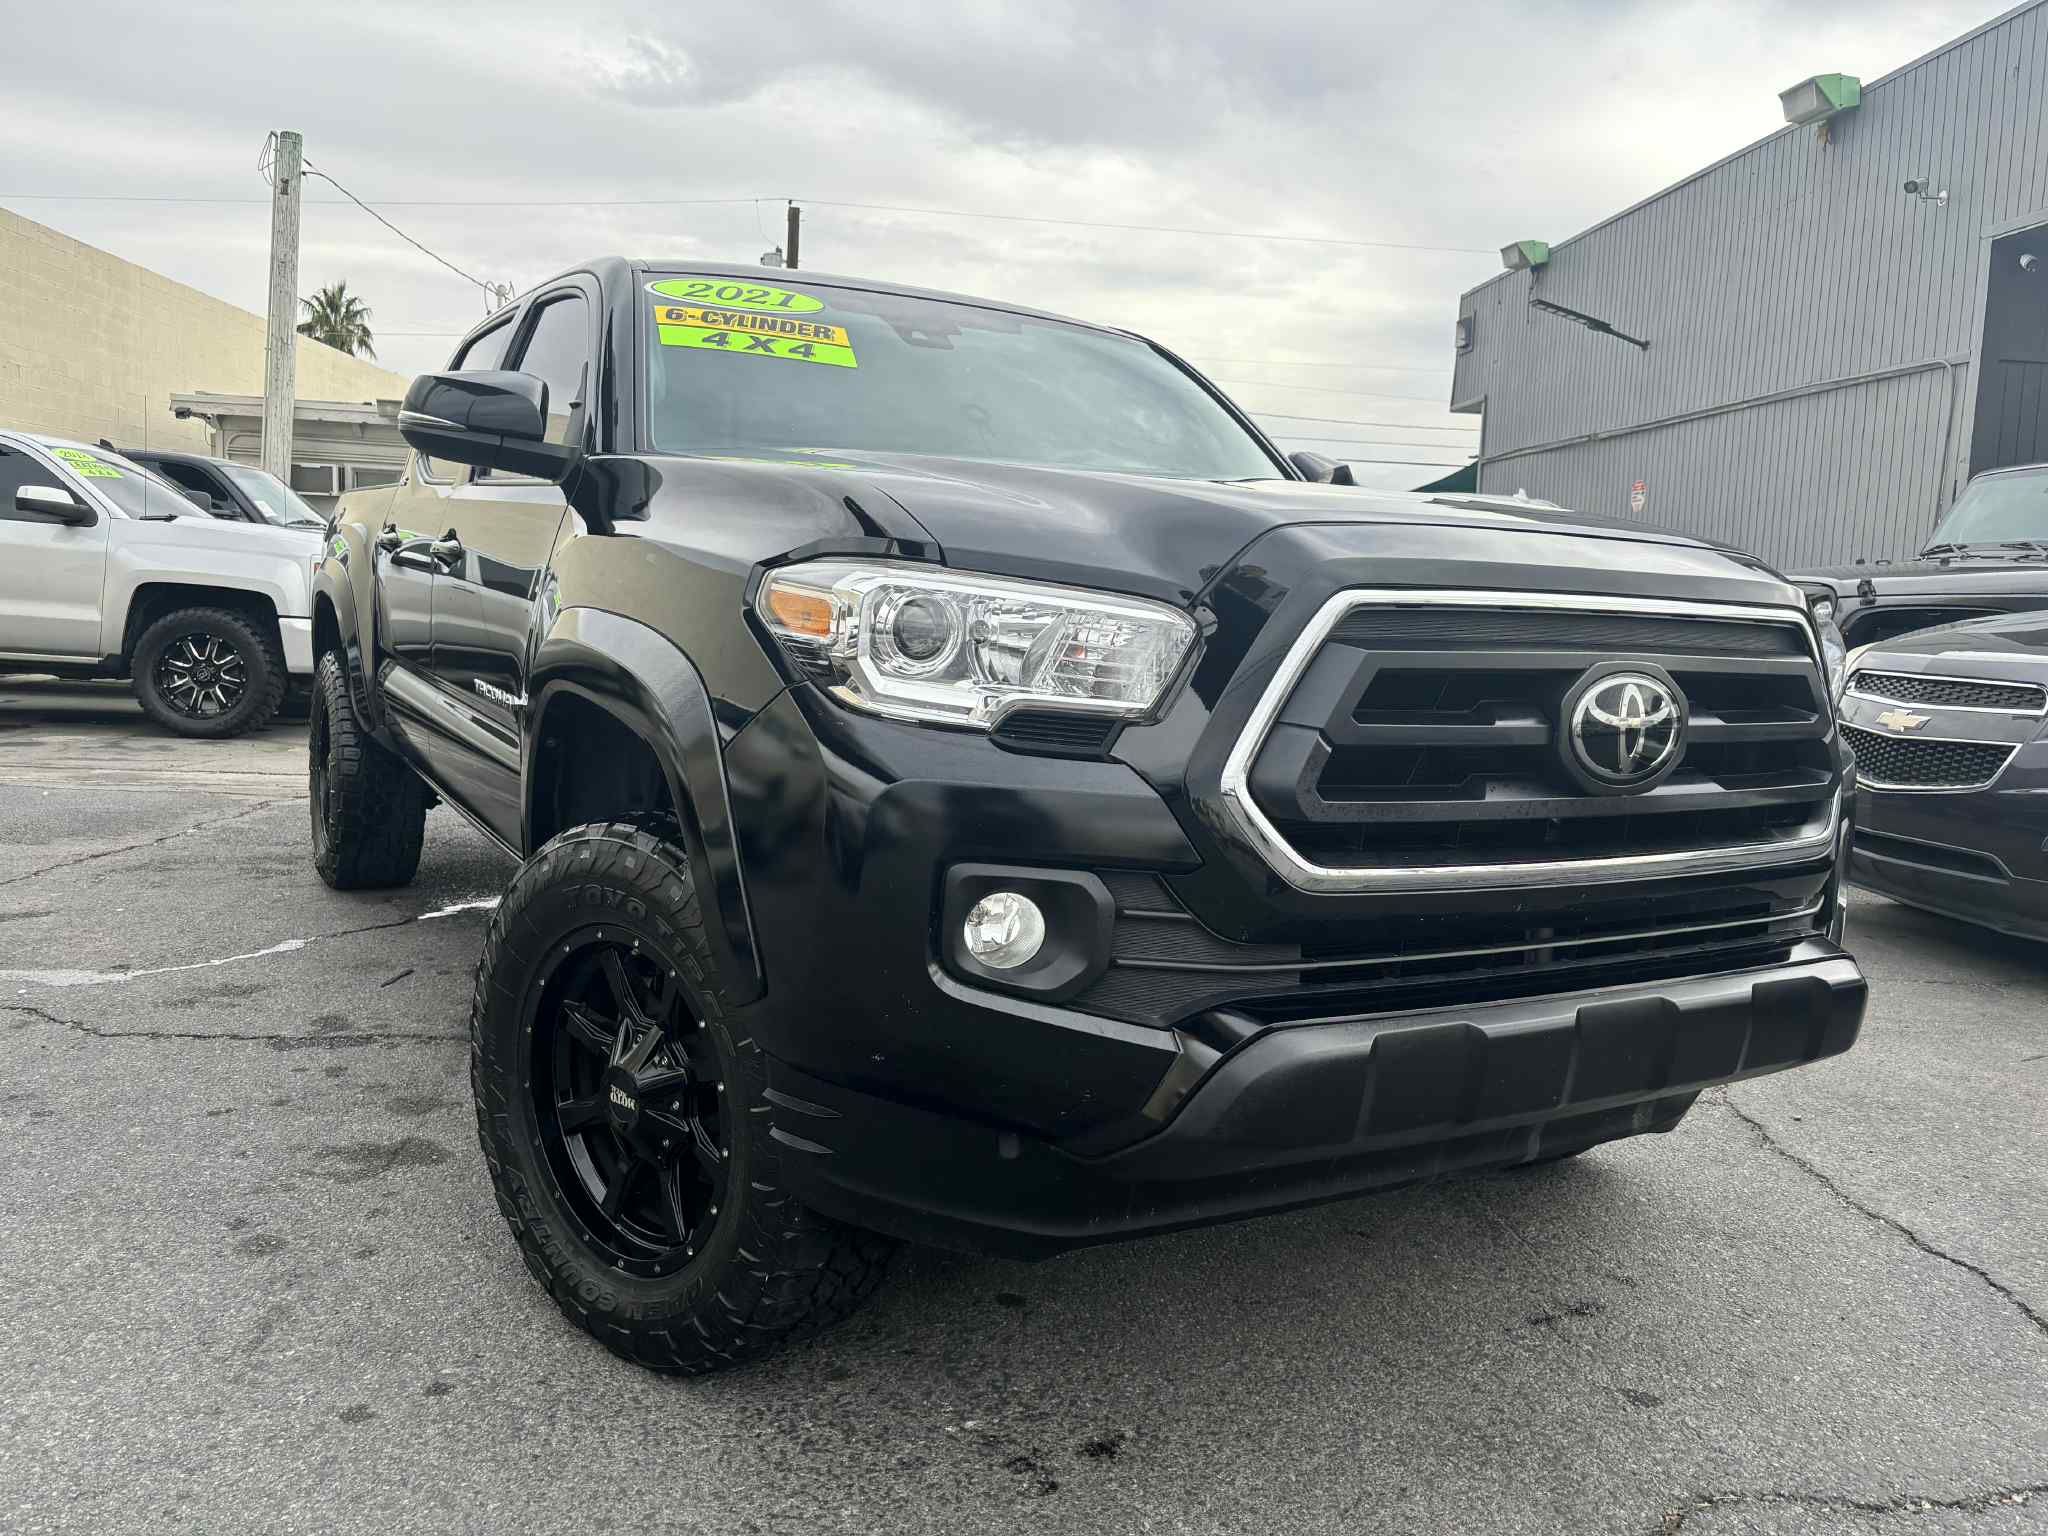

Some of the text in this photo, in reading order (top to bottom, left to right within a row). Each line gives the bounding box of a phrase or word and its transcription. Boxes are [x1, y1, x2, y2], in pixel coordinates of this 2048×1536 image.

[682, 283, 796, 308] 2021
[665, 308, 834, 339] 6-CYLINDER
[473, 678, 512, 706] TACOMA
